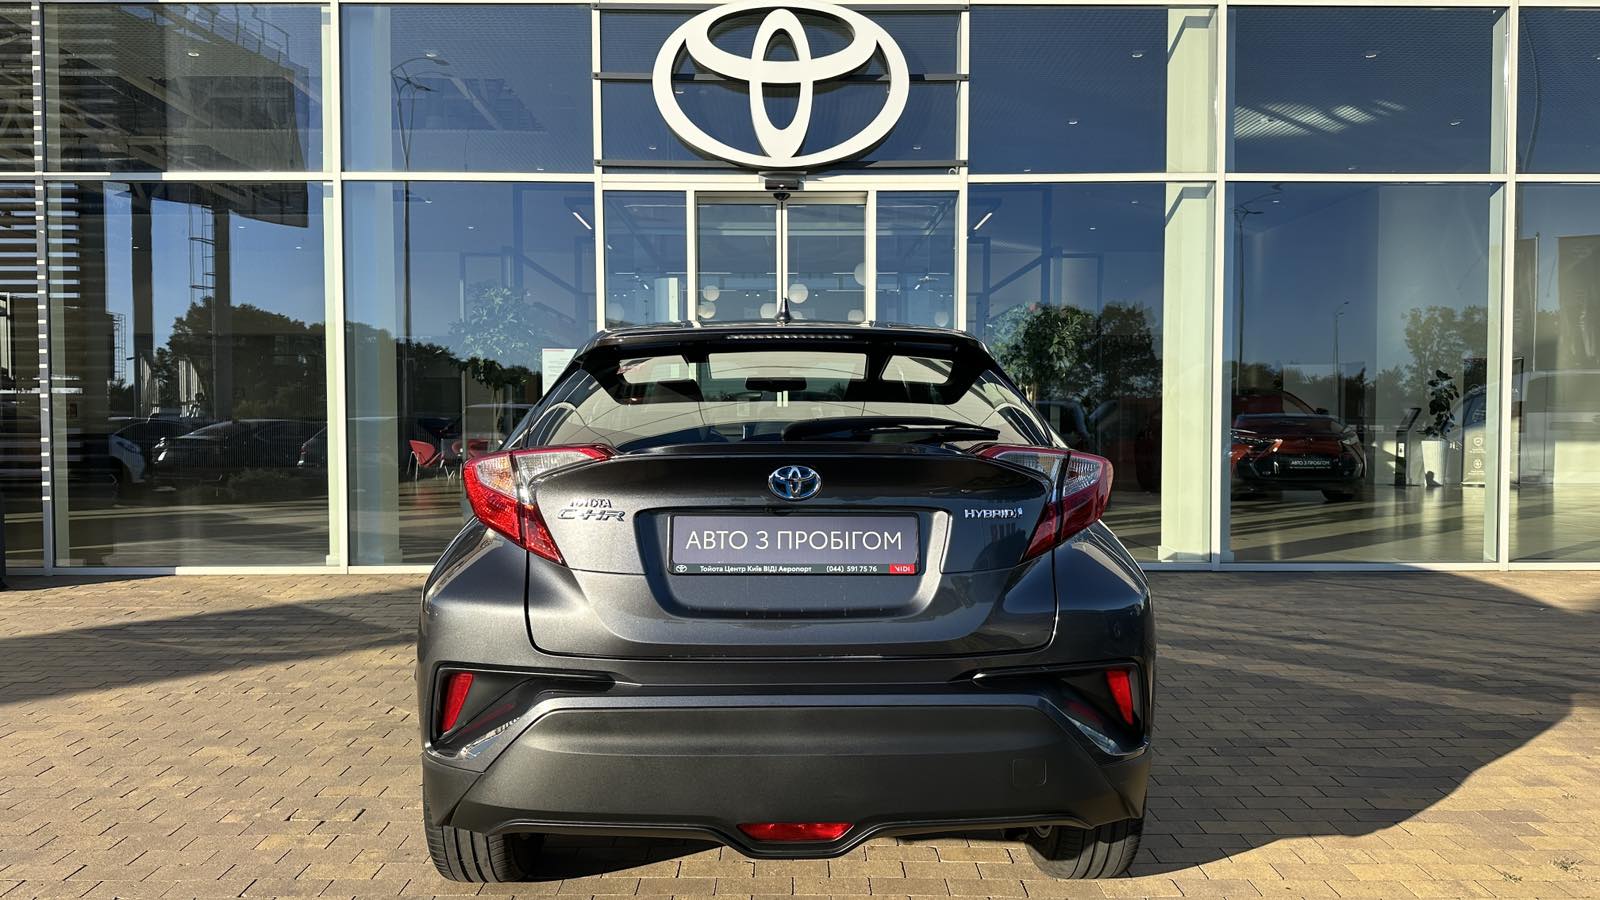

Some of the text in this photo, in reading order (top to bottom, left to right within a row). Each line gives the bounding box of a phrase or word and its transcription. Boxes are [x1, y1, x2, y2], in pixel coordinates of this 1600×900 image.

[558, 508, 626, 522] C-HR
[685, 530, 902, 551] АВТО З ПРОБІГОМ
[724, 565, 746, 573] Центр
[778, 565, 812, 573] Аеропорт
[826, 565, 844, 573] (044)
